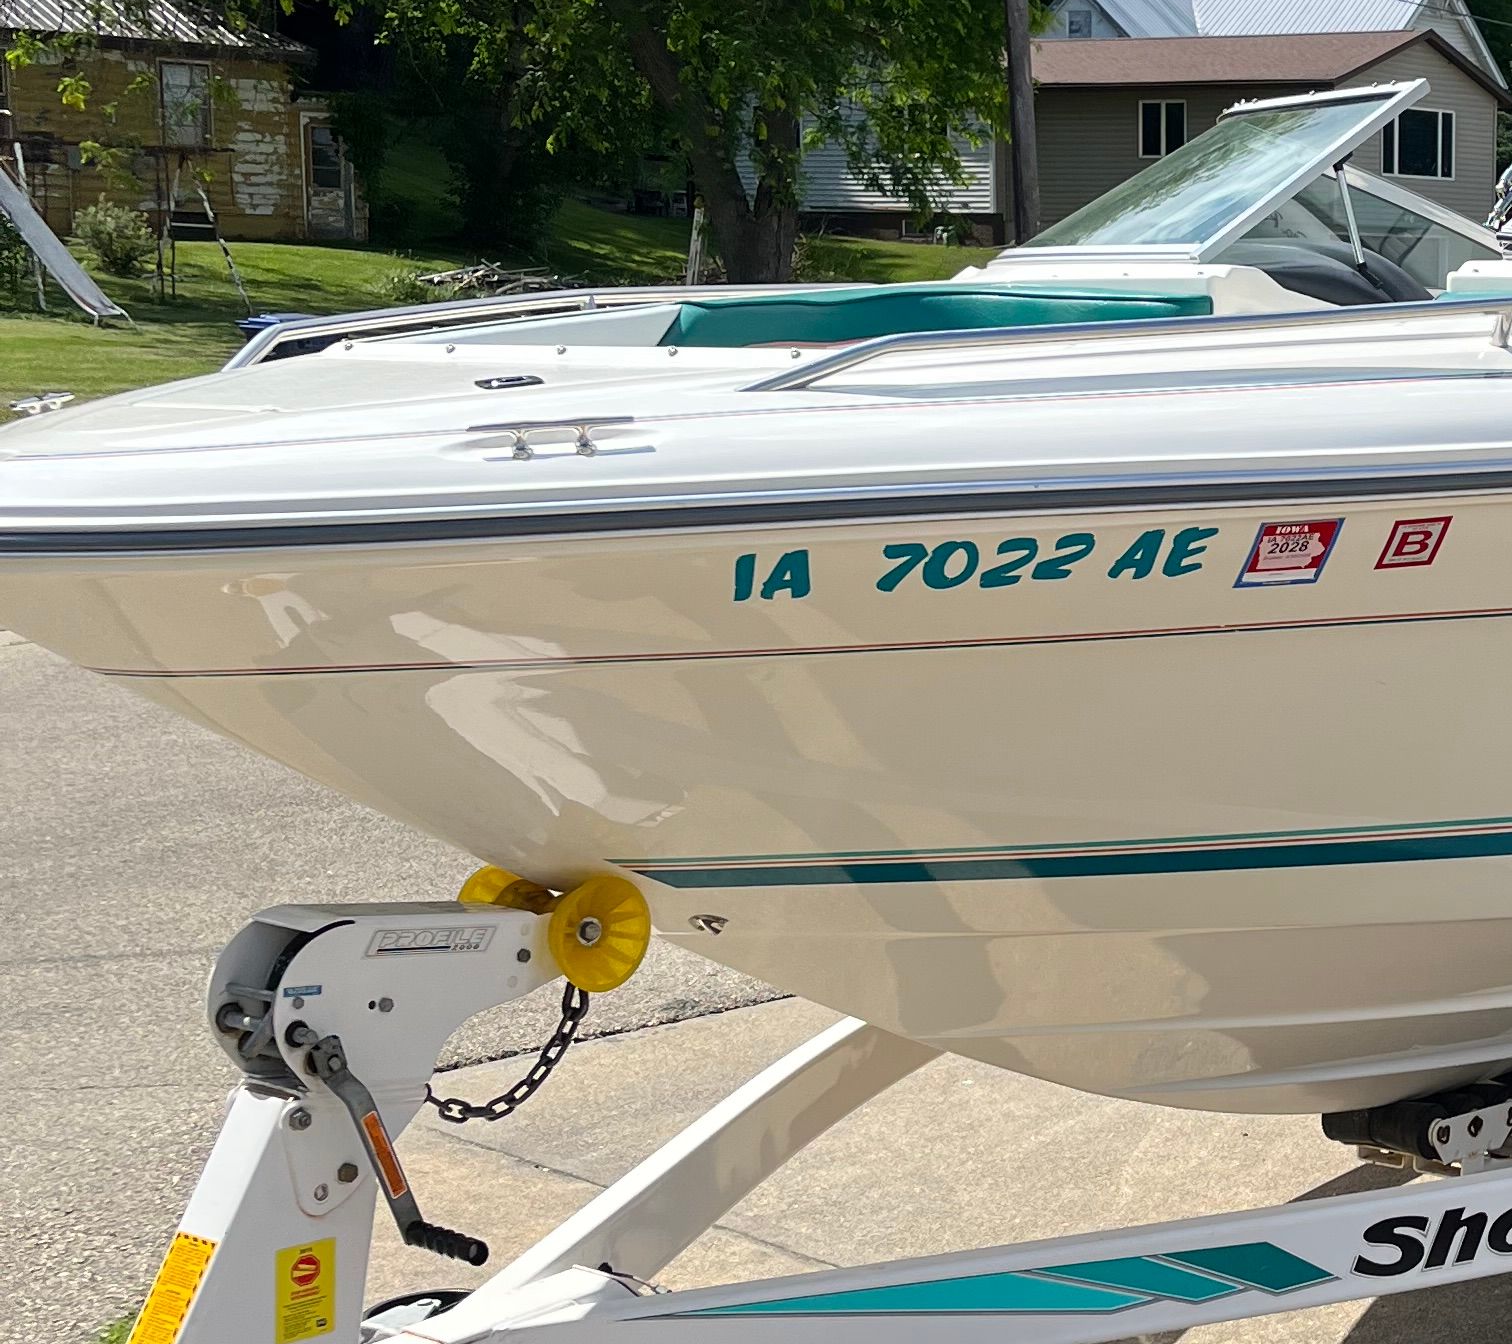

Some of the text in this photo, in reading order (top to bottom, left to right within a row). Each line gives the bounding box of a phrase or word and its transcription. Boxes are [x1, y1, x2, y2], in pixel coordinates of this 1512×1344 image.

[1275, 525, 1309, 534] IOWA
[1267, 541, 1310, 554] 2028
[1392, 530, 1433, 556] B
[734, 527, 1219, 601] IA 7022 AE
[378, 928, 488, 948] PROFILE
